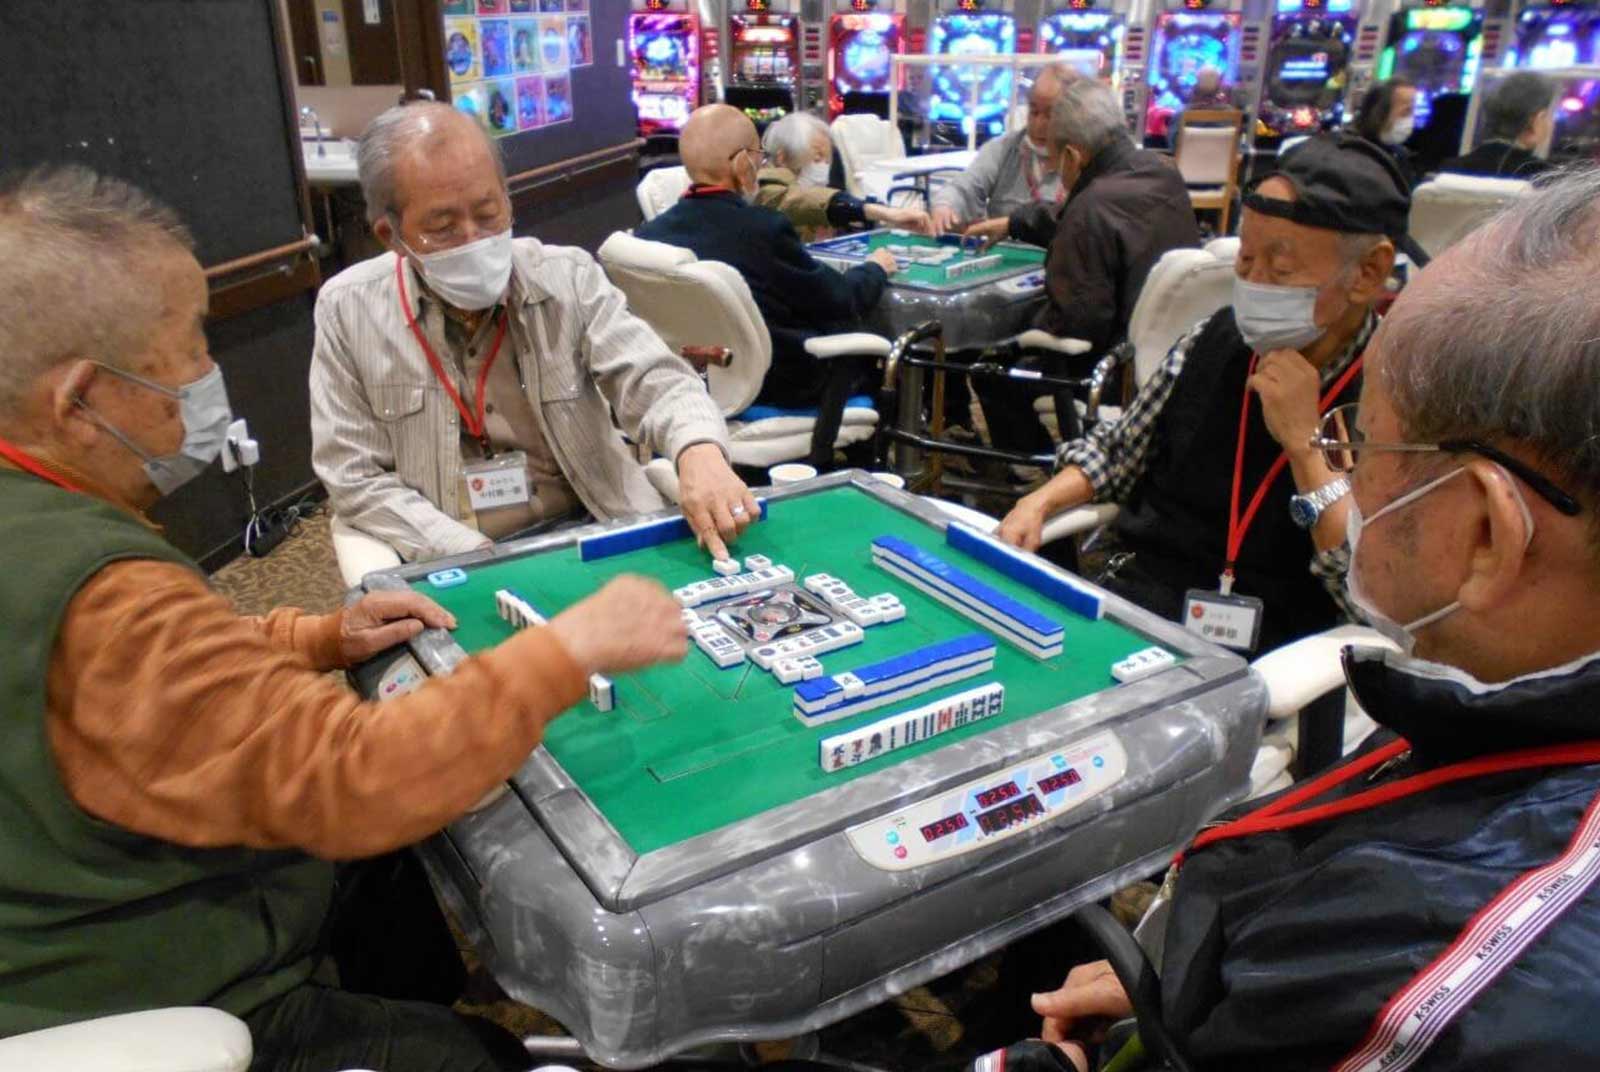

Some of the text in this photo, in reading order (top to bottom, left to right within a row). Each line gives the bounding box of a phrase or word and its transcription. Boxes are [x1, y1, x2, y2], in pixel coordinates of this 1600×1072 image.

[1536, 873, 1573, 901] K-SWISS
[1475, 924, 1513, 961] K-SWISS
[1413, 985, 1451, 1021] K-SWISS
